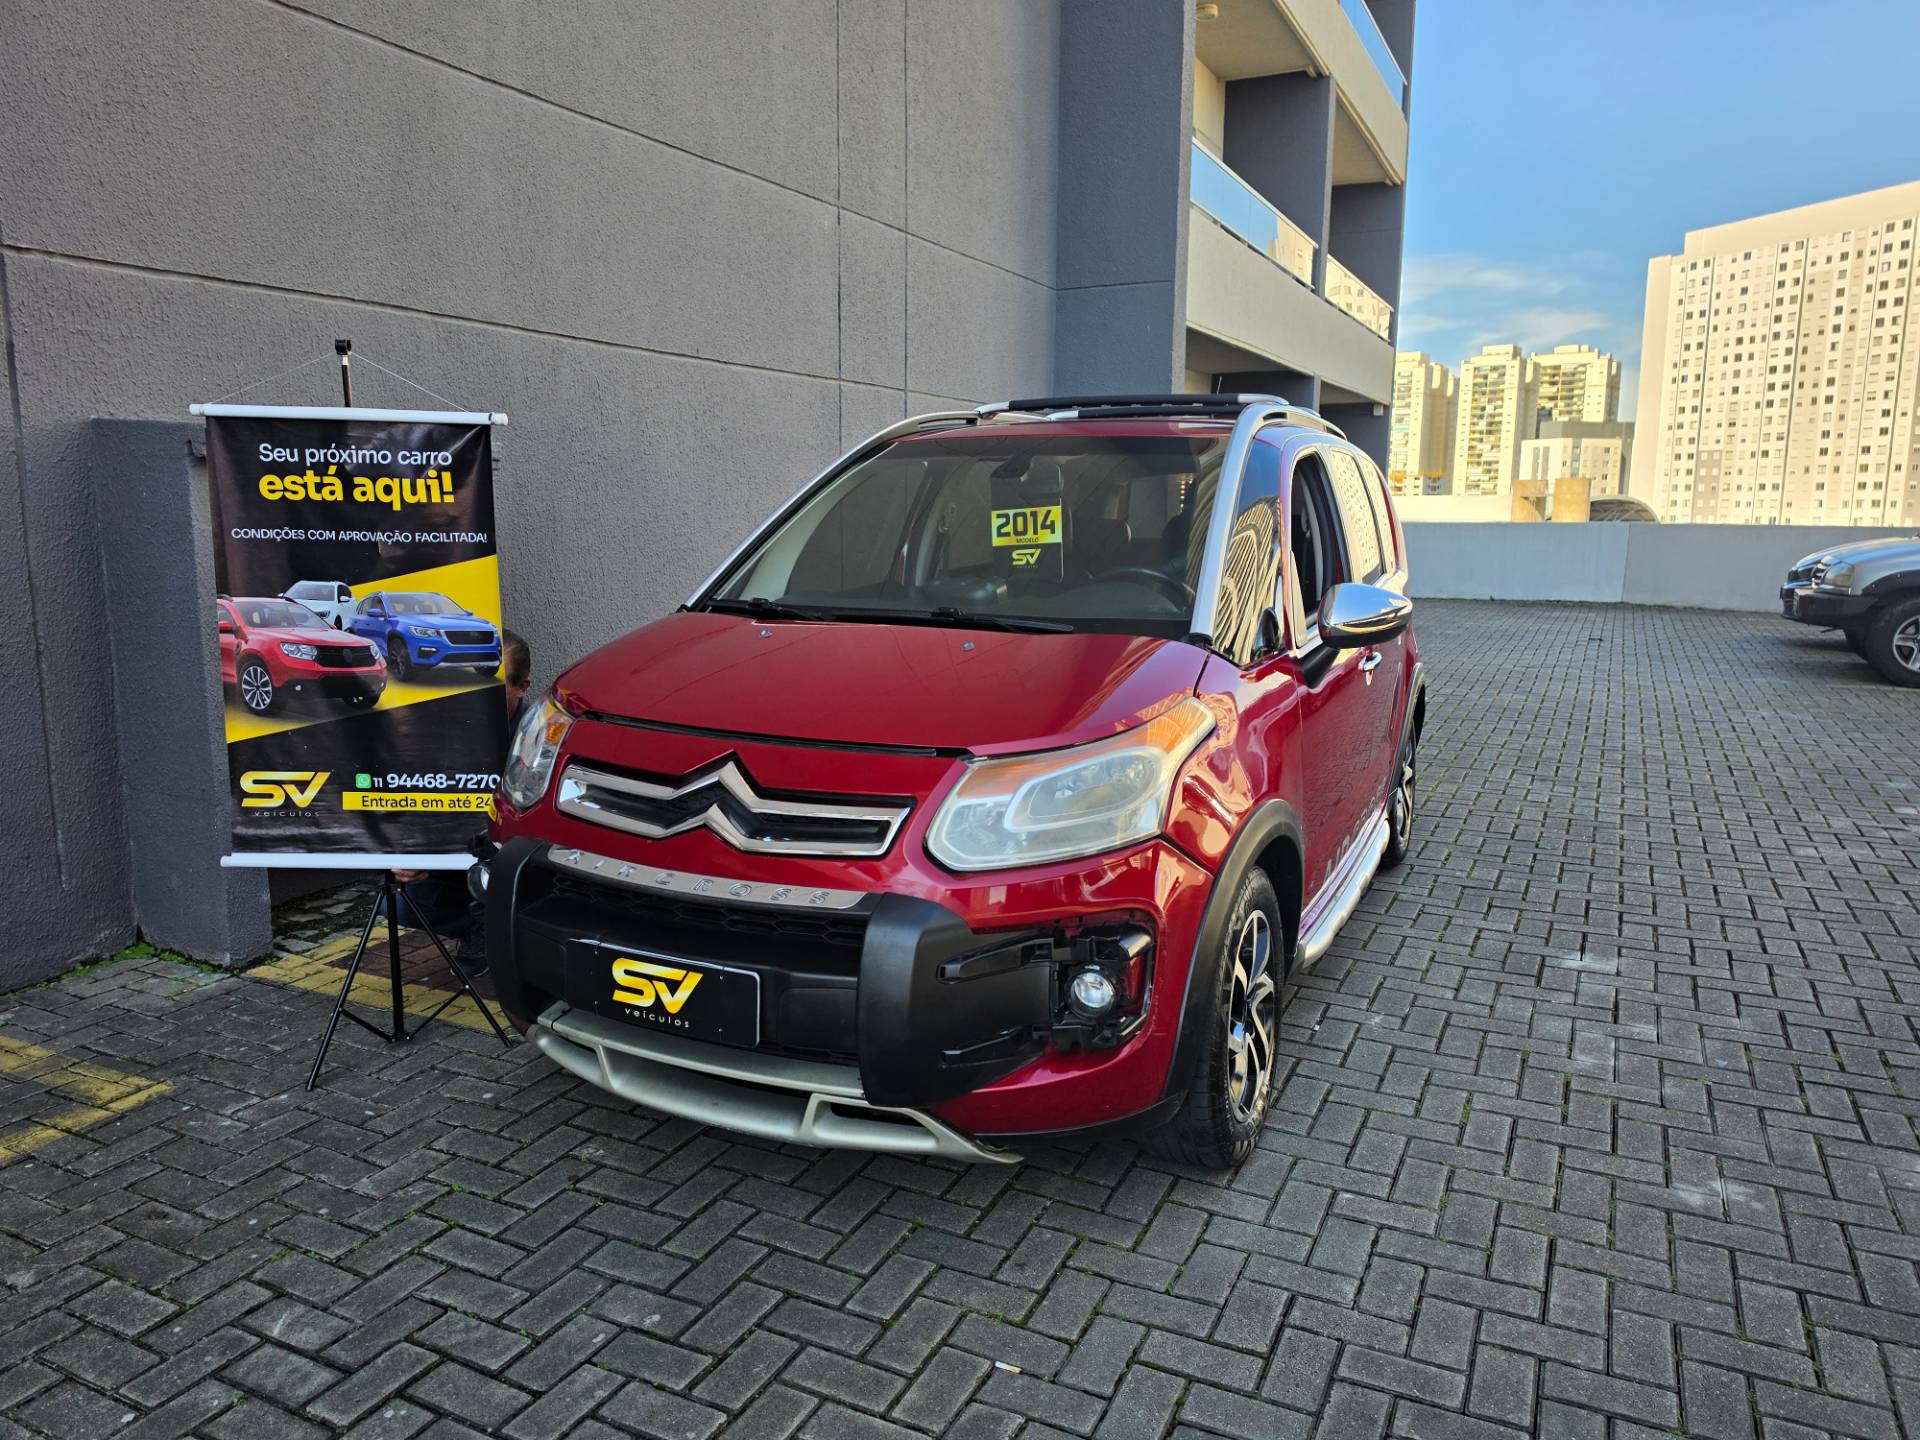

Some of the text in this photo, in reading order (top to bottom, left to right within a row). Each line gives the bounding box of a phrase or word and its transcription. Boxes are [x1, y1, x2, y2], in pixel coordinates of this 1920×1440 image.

[258, 443, 452, 466] Seu próximo carro
[258, 466, 455, 511] está aqui!
[231, 527, 488, 545] CONDIÇÕES COM APROVAÇÃO FACILITADA!
[996, 510, 1056, 537] 2014
[1012, 548, 1042, 565] SV
[239, 770, 332, 808] SV
[386, 773, 501, 789] 94468-7270
[361, 795, 418, 808] Entrada
[421, 799, 444, 808] em
[448, 796, 472, 809] até
[563, 848, 831, 905] AIRCROSS
[612, 957, 704, 1014] SV
